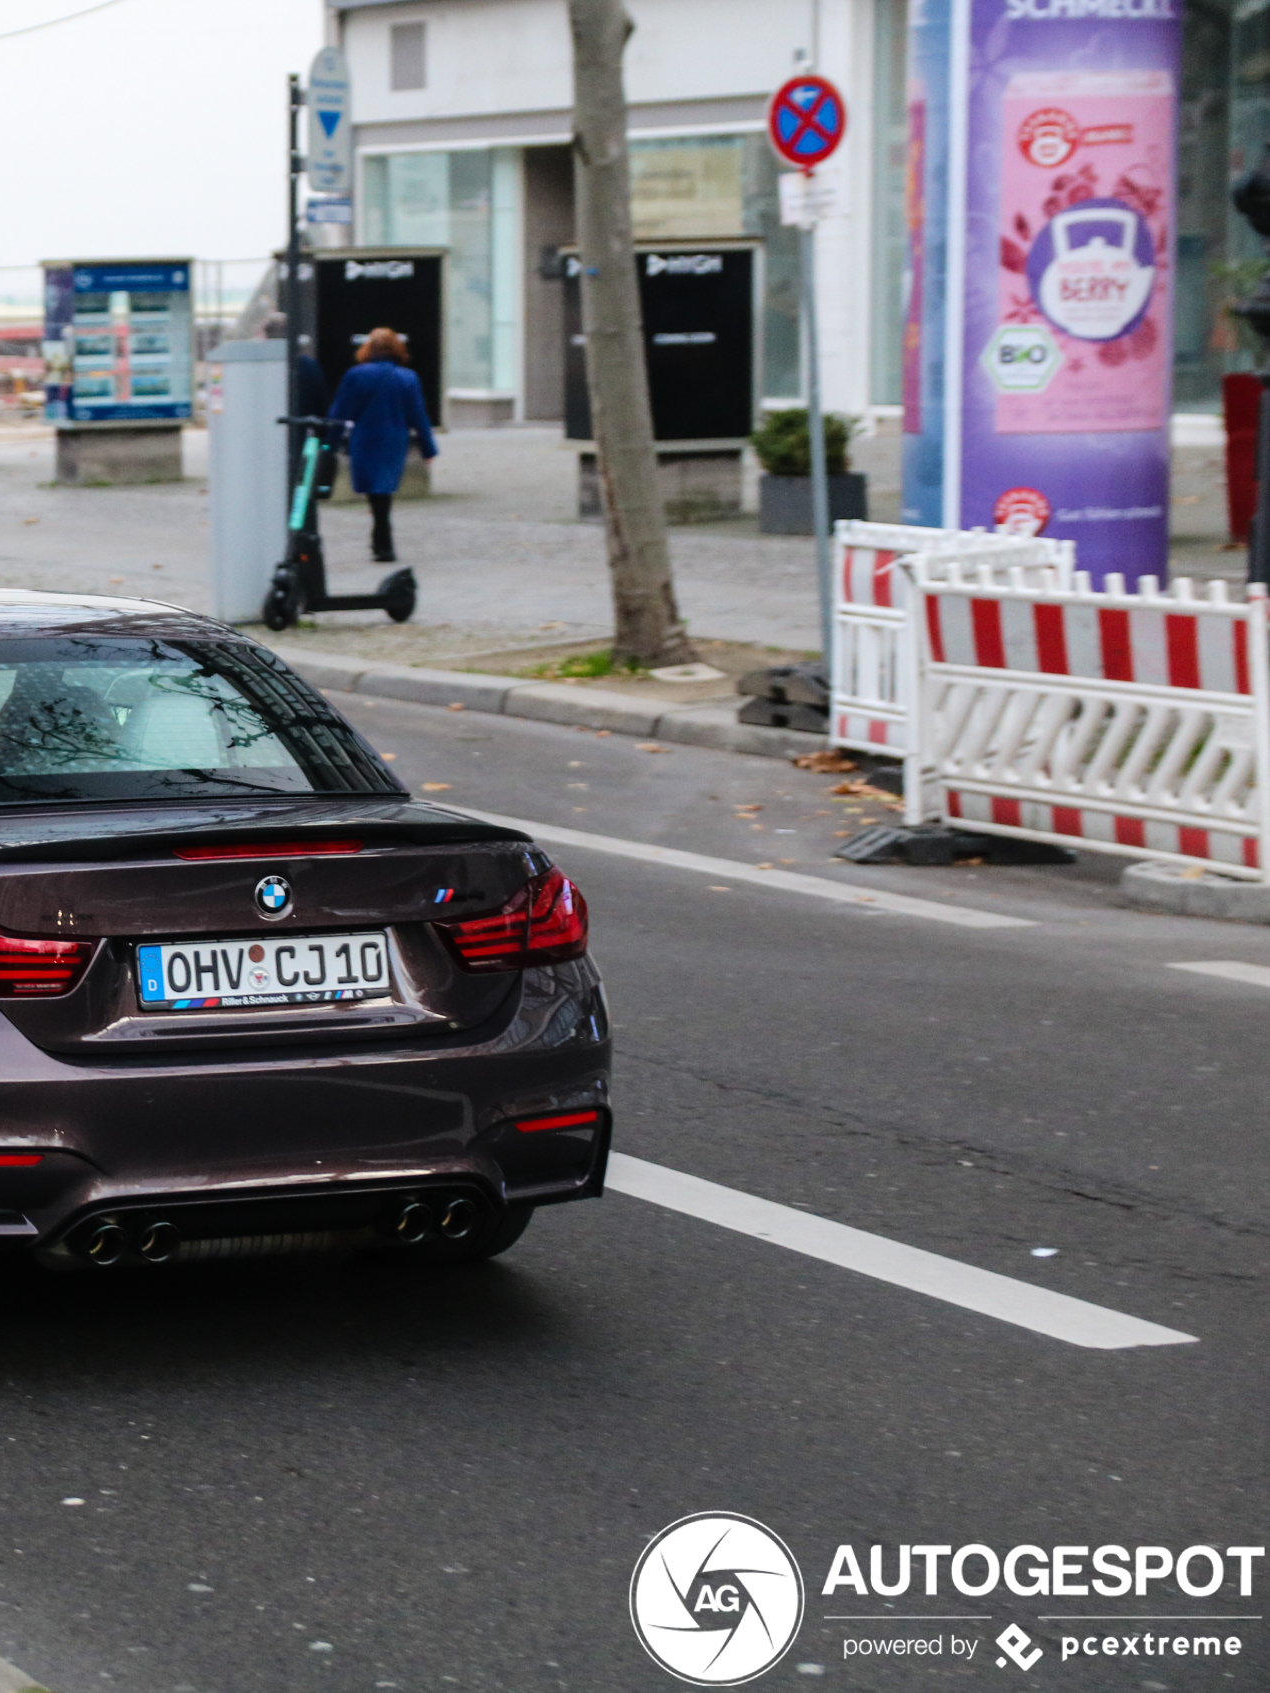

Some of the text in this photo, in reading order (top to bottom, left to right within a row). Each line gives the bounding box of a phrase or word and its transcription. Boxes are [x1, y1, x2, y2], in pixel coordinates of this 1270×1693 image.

[1058, 276, 1130, 303] BERRY
[167, 948, 244, 993] OHV
[148, 979, 158, 992] D
